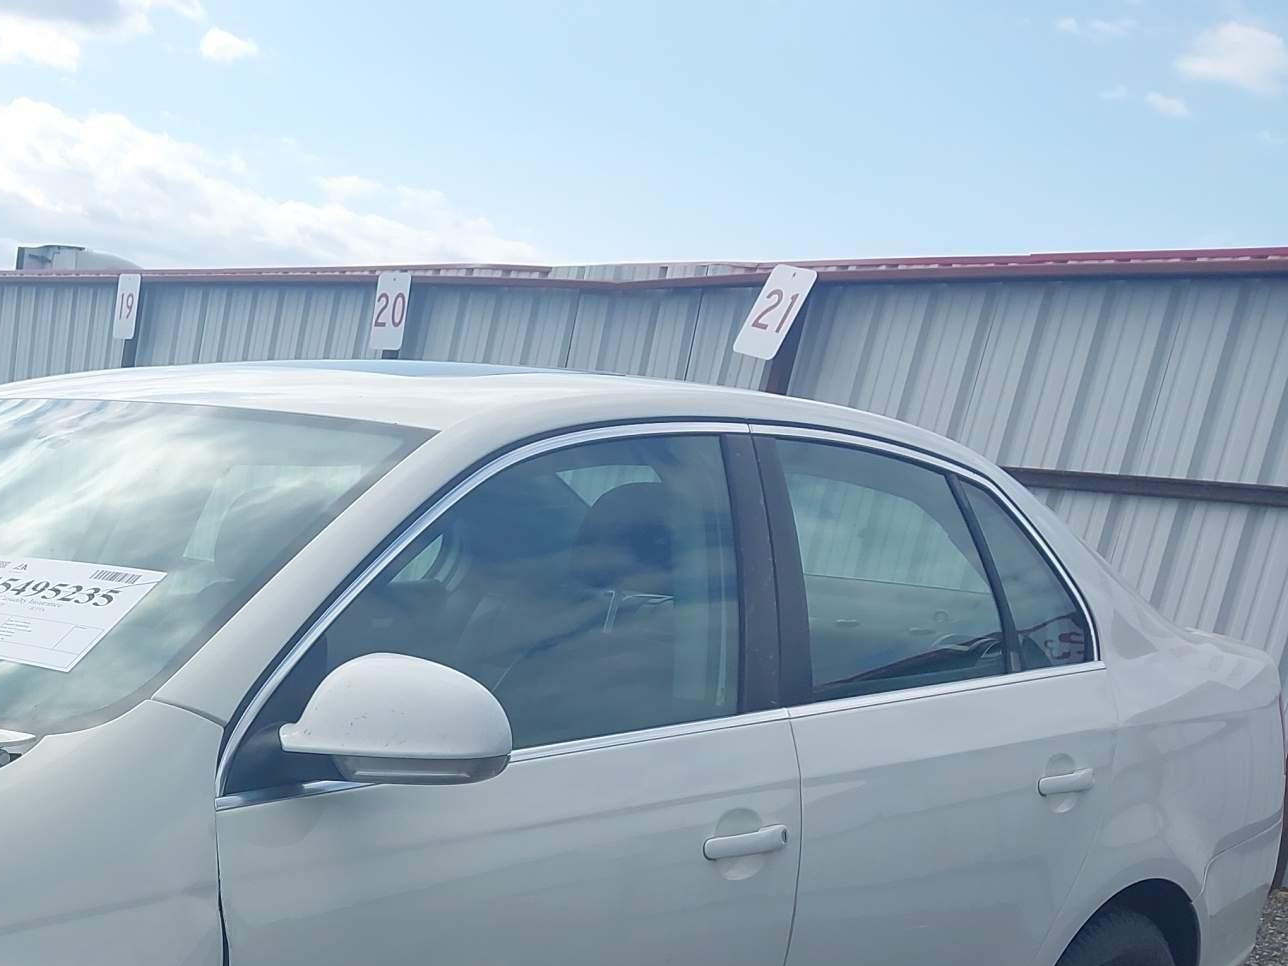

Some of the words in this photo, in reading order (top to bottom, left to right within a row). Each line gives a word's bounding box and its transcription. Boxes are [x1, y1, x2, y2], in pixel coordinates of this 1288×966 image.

[118, 292, 135, 320] 19
[373, 291, 407, 328] 20
[751, 288, 800, 334] 21
